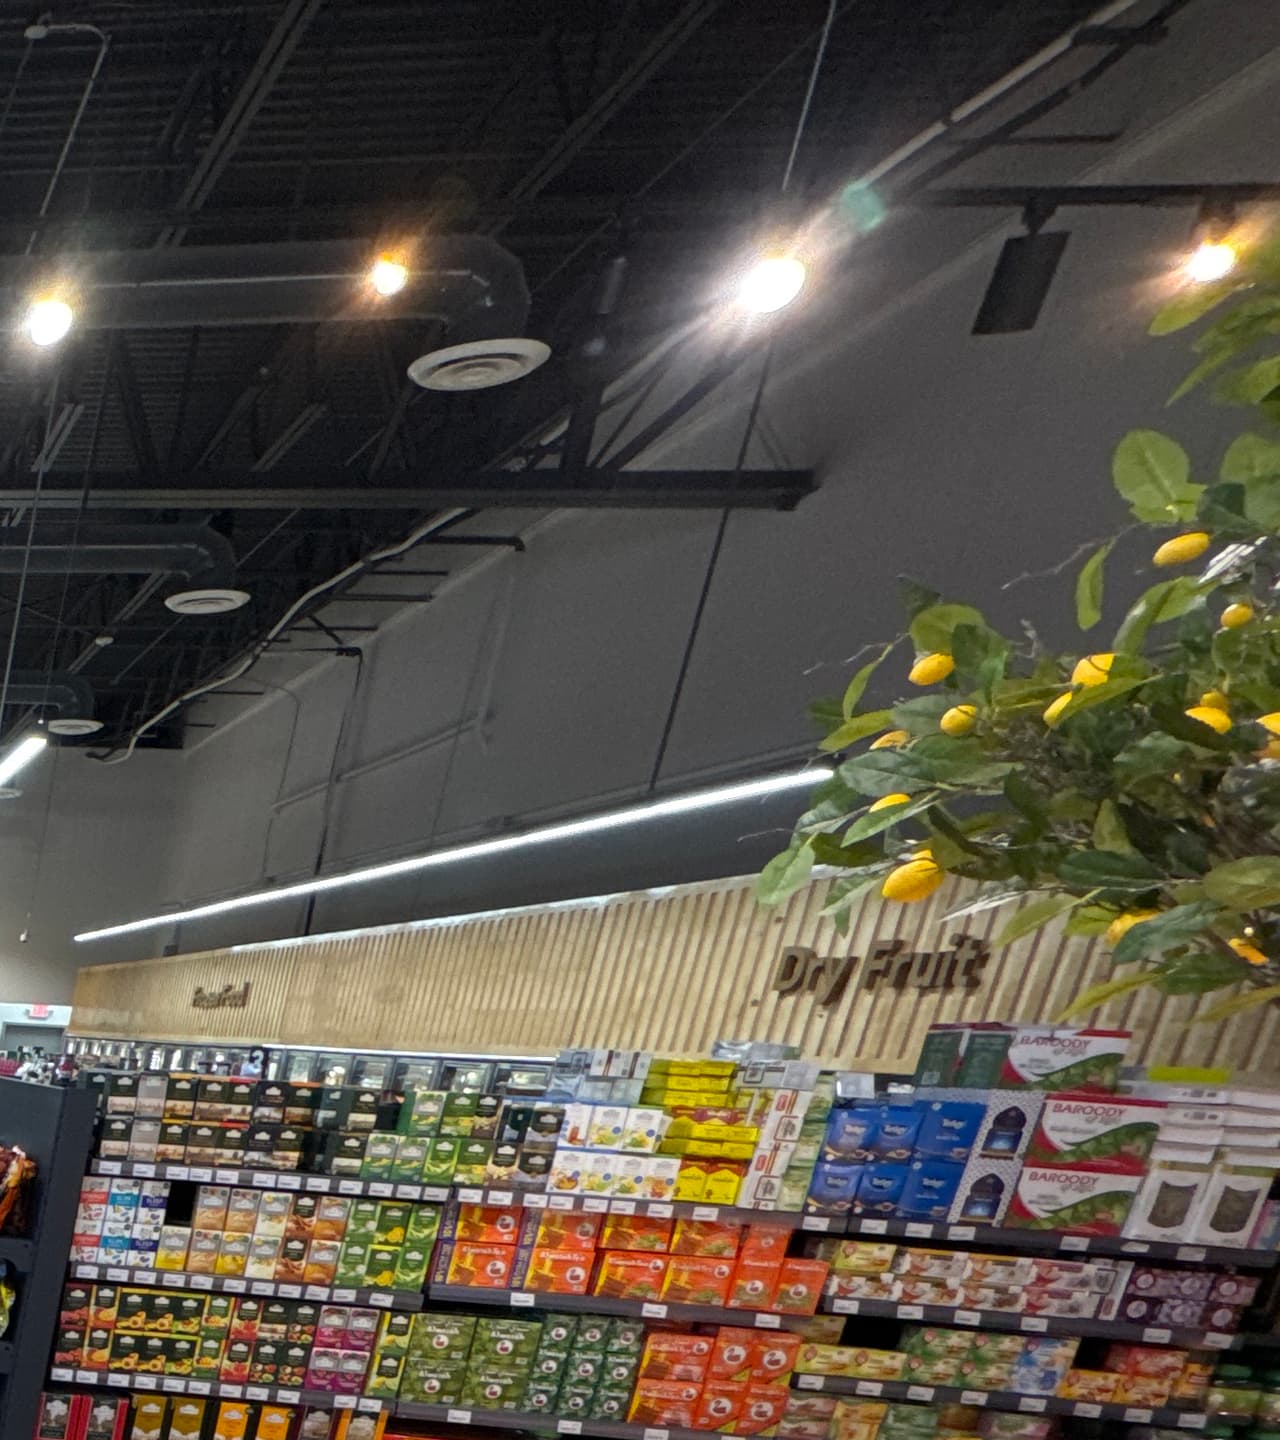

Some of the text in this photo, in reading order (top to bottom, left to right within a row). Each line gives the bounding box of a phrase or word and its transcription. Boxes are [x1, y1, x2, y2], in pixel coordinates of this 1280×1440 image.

[772, 933, 989, 1007] Dry Fruit
[1052, 1102, 1127, 1118] BAROODY
[1028, 1171, 1100, 1186] BAROODY
